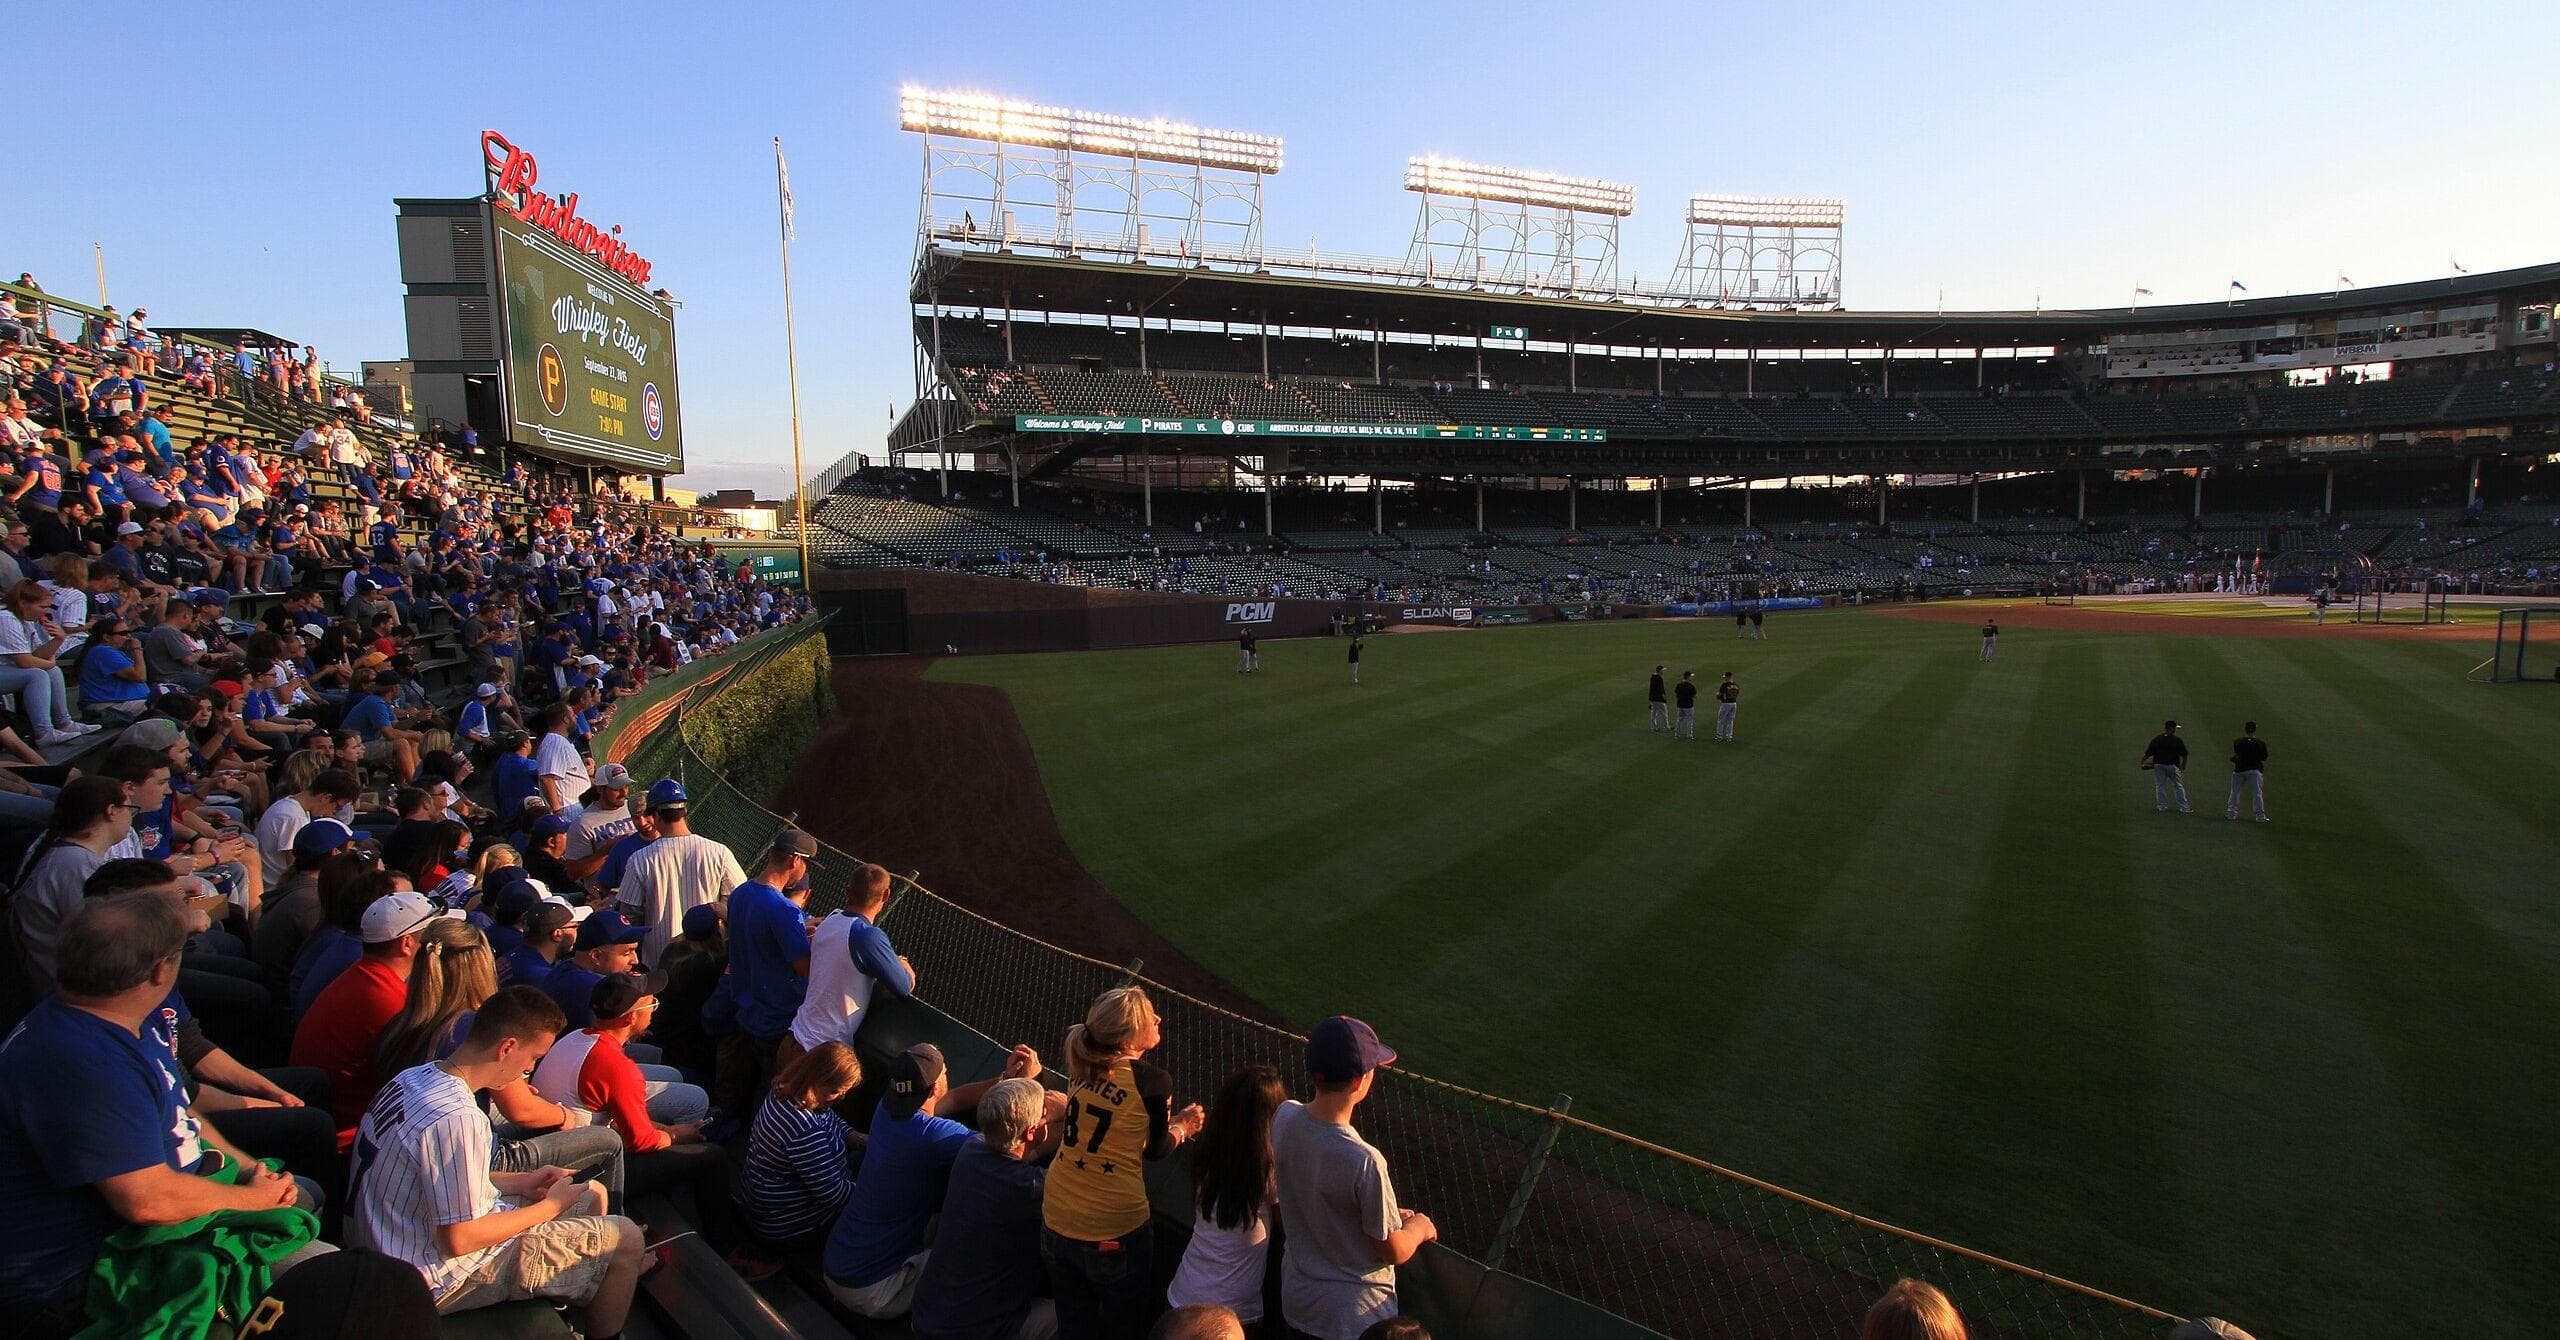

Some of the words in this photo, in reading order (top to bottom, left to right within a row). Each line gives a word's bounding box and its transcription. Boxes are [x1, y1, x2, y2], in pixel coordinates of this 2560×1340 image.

[482, 130, 651, 285] Budweiser
[551, 295, 609, 347] Wrigley
[613, 317, 647, 366] Field
[584, 355, 609, 375] September
[591, 387, 609, 408] GAME
[609, 394, 627, 413] START
[613, 418, 624, 437] PM
[1025, 418, 1060, 429] Welcome
[1061, 419, 1070, 429] to
[1071, 419, 1103, 431] Wrigley
[1104, 420, 1125, 430] Field
[1154, 421, 1182, 431] PIRATES
[1238, 423, 1255, 432] CUBS
[1300, 425, 1314, 433] LAST
[1314, 425, 1332, 433] START
[371, 533, 385, 546] 12
[1225, 602, 1276, 620] PCM
[1402, 607, 1452, 620] SLOAN
[594, 817, 633, 841] NORT
